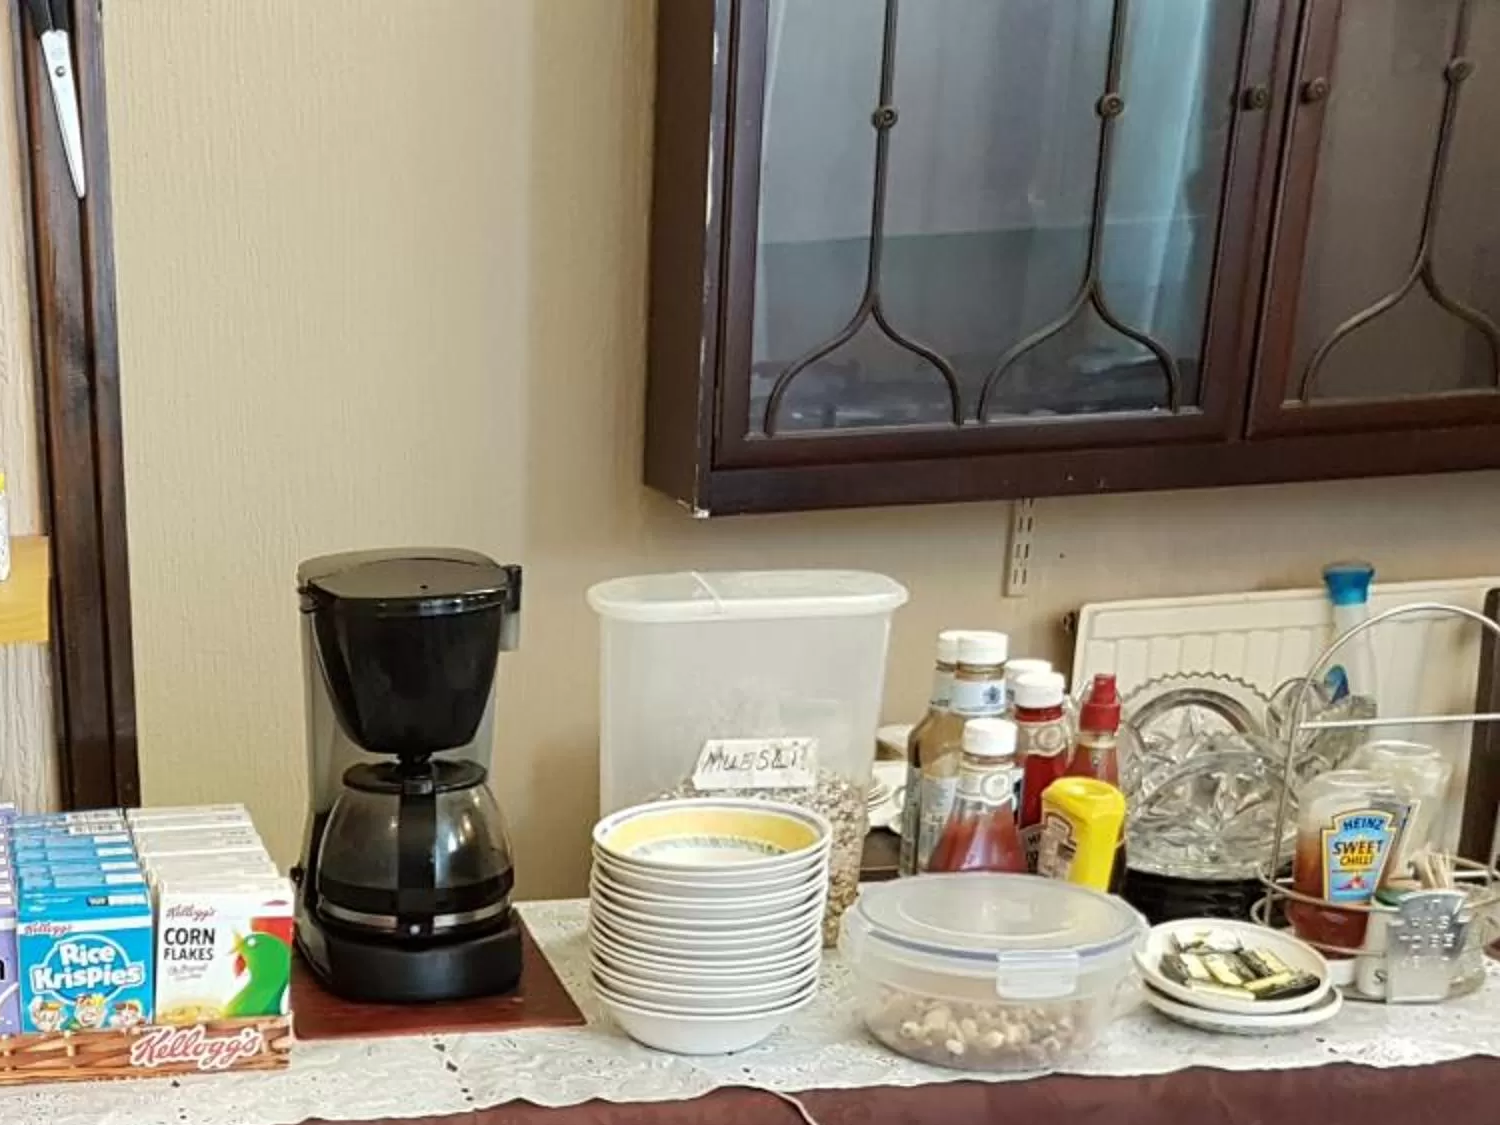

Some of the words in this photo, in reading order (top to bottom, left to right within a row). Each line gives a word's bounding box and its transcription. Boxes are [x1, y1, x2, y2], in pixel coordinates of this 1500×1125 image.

[1343, 816, 1385, 831] HEINZ
[1333, 840, 1384, 855] SWEET
[163, 927, 215, 946] CORN
[60, 943, 115, 966] Rice
[163, 947, 213, 961] FLAKES
[34, 962, 141, 990] Krispies
[133, 1028, 258, 1068] Kellogg's
